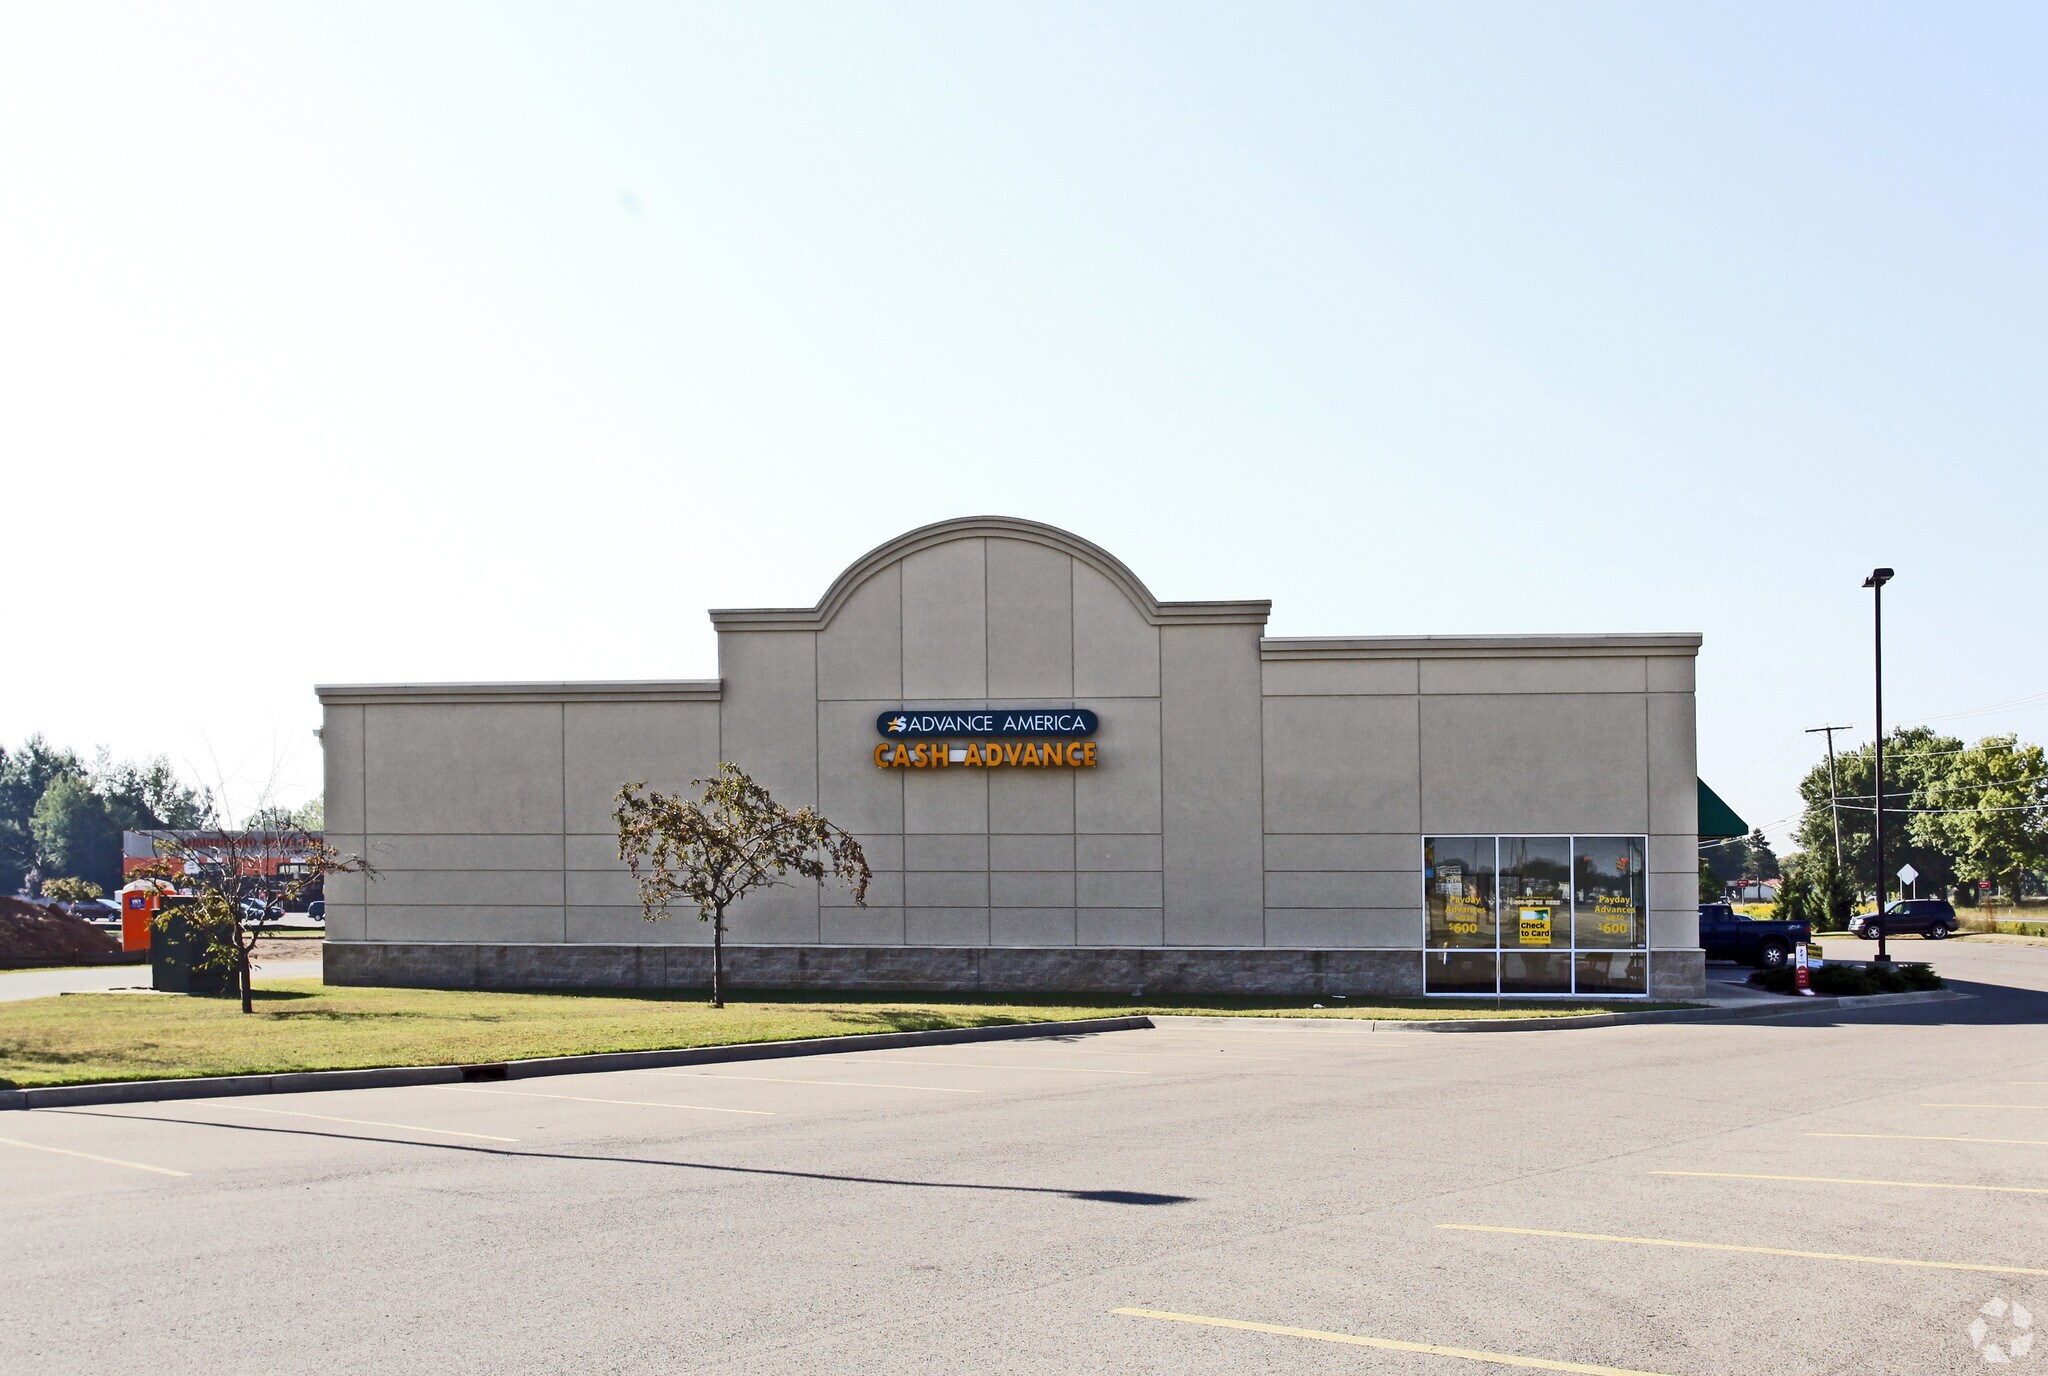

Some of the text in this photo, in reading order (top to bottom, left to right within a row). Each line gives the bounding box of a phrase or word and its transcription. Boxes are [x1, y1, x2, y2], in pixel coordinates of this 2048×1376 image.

[908, 715, 1086, 732] ADVANCE AMERICA
[874, 742, 1097, 768] CASH ADVANCE
[182, 838, 256, 849] LUMBERARD
[1450, 895, 1481, 905] Payday
[1599, 895, 1630, 904] Payday
[1445, 905, 1486, 913] Advances
[1595, 905, 1636, 913] Advances
[1448, 923, 1477, 933] $600
[1599, 923, 1627, 933] $600
